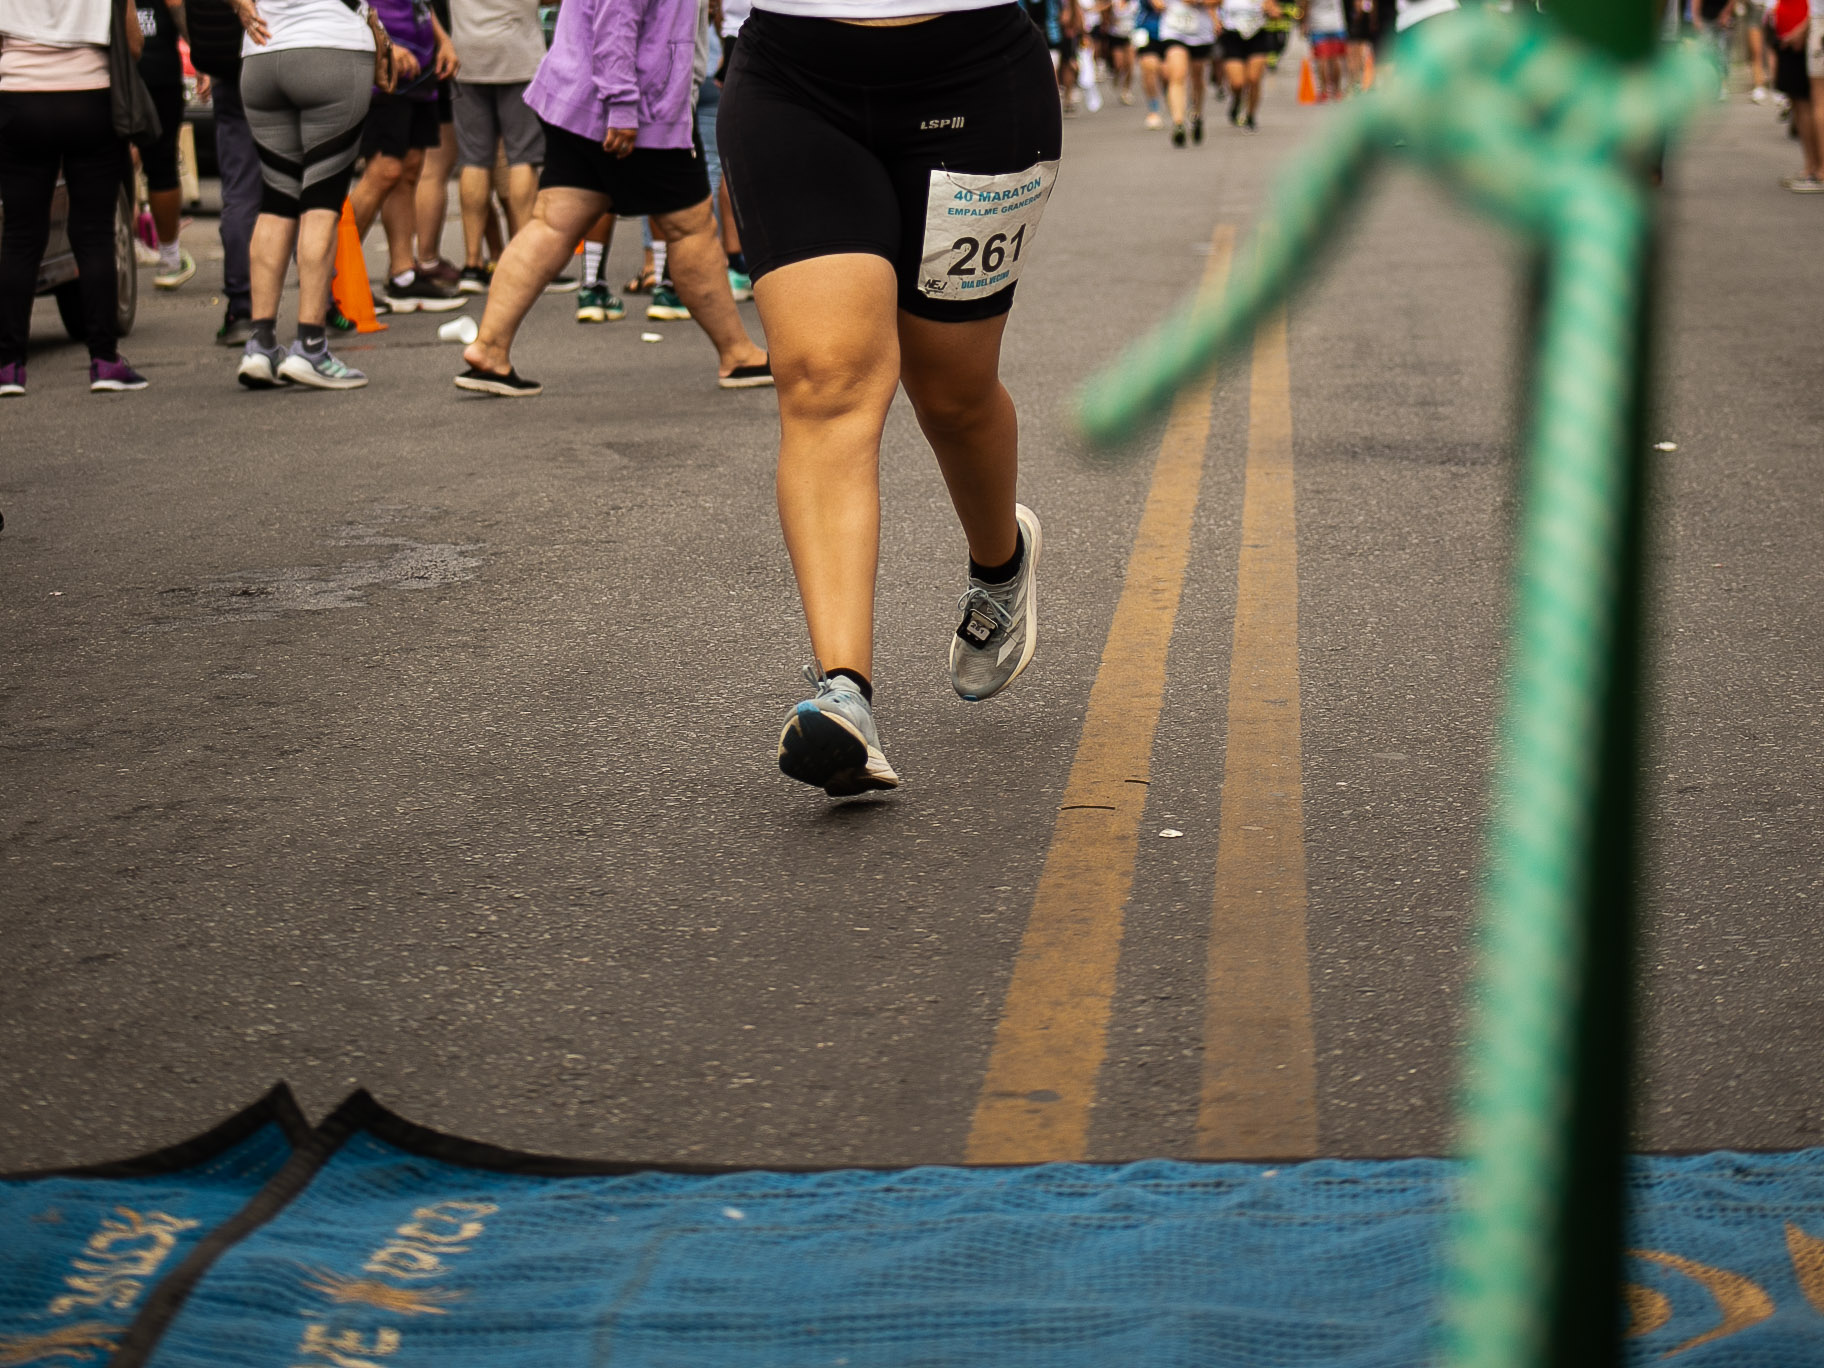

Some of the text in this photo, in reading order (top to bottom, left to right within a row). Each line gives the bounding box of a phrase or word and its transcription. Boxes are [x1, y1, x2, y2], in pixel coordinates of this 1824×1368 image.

[954, 177, 1041, 202] 40 MARATON
[947, 192, 1042, 216] EMPALME GRANEROS
[946, 223, 1027, 276] 261
[924, 279, 948, 290] NEJ
[961, 281, 975, 290] DIA
[976, 278, 988, 288] DEL
